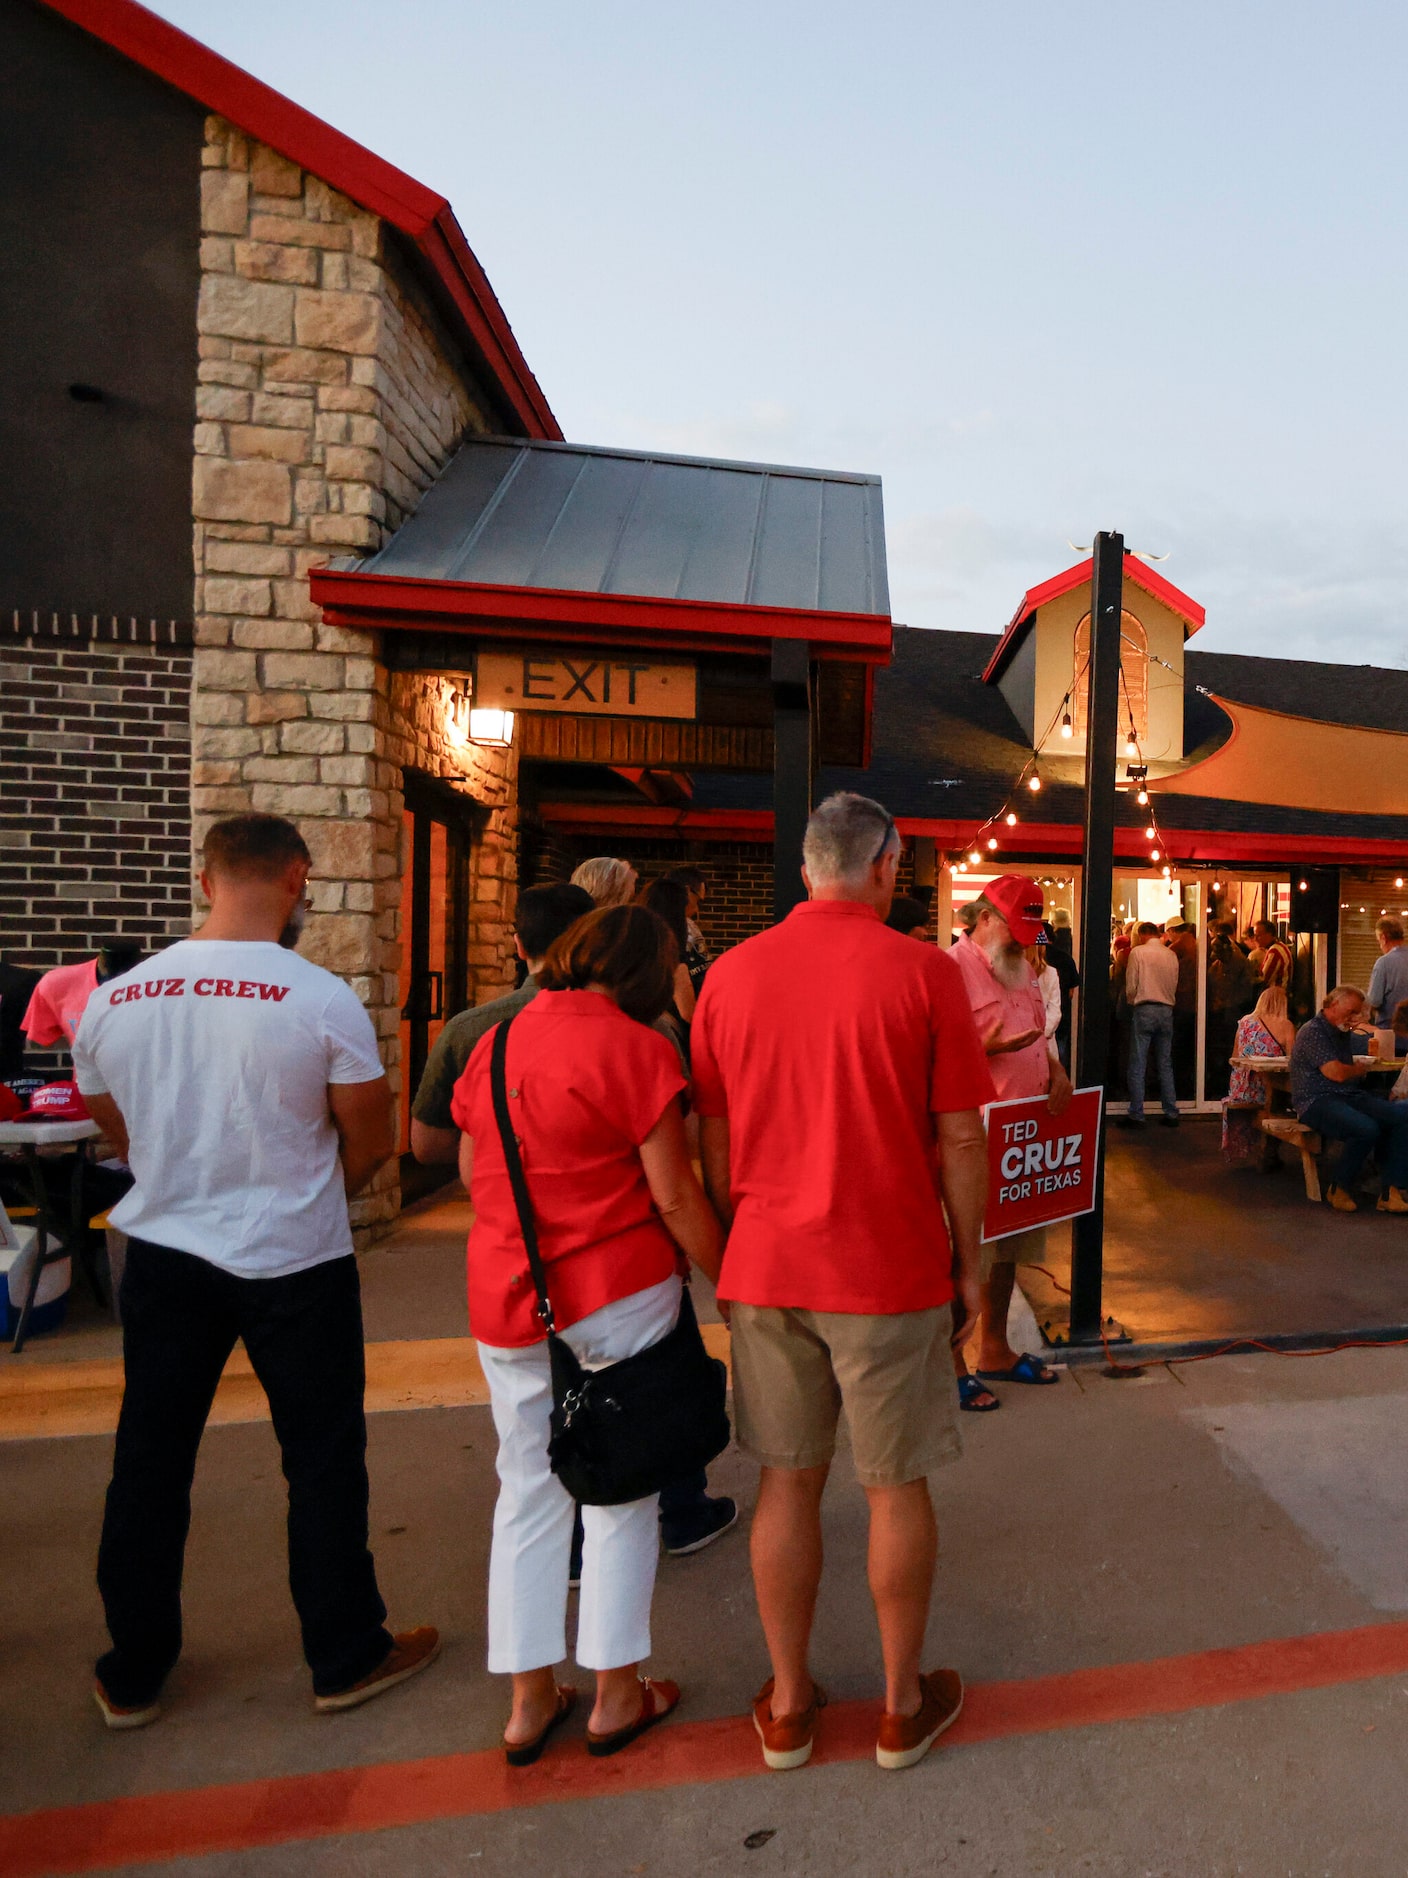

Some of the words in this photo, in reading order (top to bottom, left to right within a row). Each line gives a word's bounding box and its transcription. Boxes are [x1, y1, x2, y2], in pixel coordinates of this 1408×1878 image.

[522, 656, 650, 705] EXIT
[109, 978, 186, 1006] CRUZ
[194, 978, 291, 1002] CREW
[1002, 1119, 1038, 1144] TED
[1001, 1134, 1083, 1180] CRUZ
[1000, 1181, 1031, 1205] FOR
[1035, 1169, 1081, 1195] TEXAS
